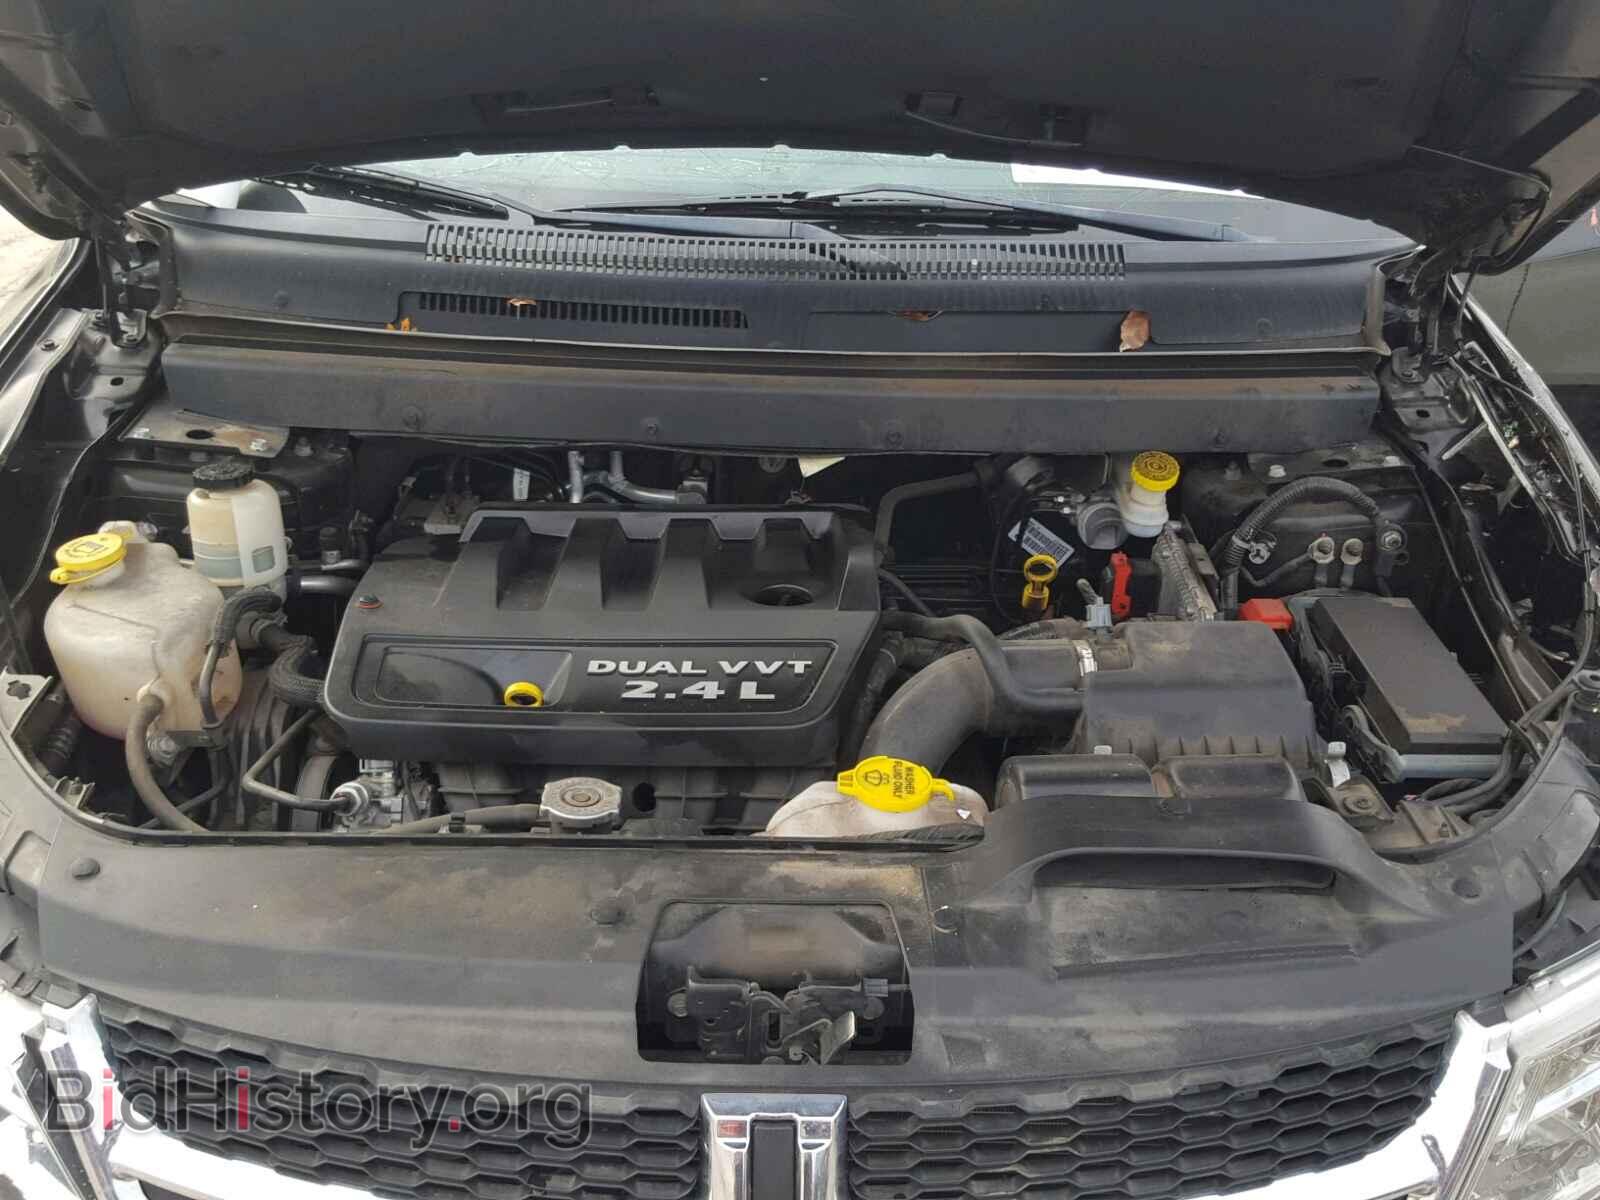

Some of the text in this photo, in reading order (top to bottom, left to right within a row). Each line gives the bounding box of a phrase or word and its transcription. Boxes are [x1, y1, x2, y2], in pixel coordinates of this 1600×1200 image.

[587, 660, 813, 674] DUAL VVT
[621, 680, 776, 700] 2.4 L
[893, 761, 903, 799] FLUID ONLY
[904, 767, 916, 795] WASHER
